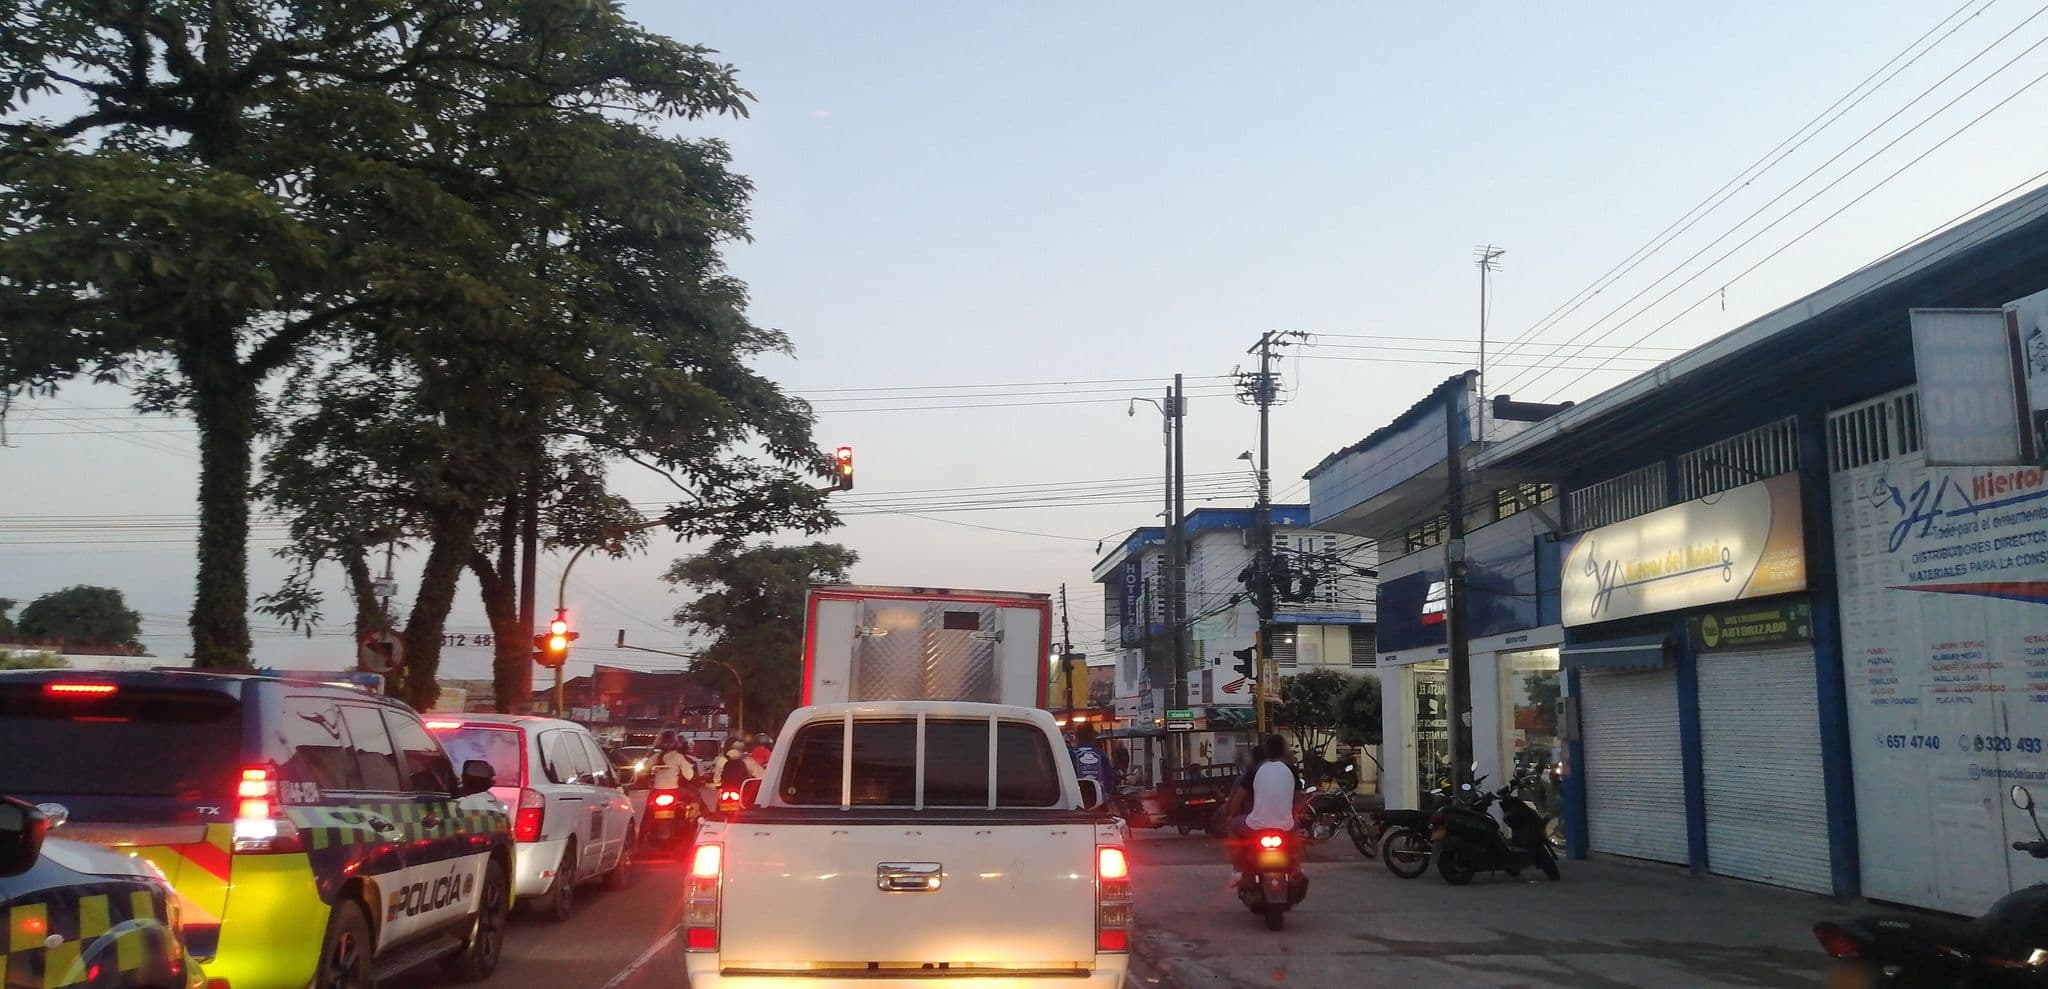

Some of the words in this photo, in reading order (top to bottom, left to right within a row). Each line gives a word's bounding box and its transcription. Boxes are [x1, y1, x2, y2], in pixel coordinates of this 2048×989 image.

[1911, 540, 1991, 565] DISTRIBUIDORES
[1994, 530, 2046, 551] DIRECTOS
[1909, 563, 1968, 582] MATERIALES
[1970, 559, 1996, 573] PARA
[1999, 557, 2013, 570] LA
[1721, 621, 1788, 638] AUTORIZADO
[1886, 735, 1906, 749] 657
[1910, 735, 1940, 750] 4740
[1985, 736, 2012, 752] 320
[2016, 737, 2042, 753] 493
[196, 806, 221, 815] TX
[387, 863, 461, 922] POLICÍA
